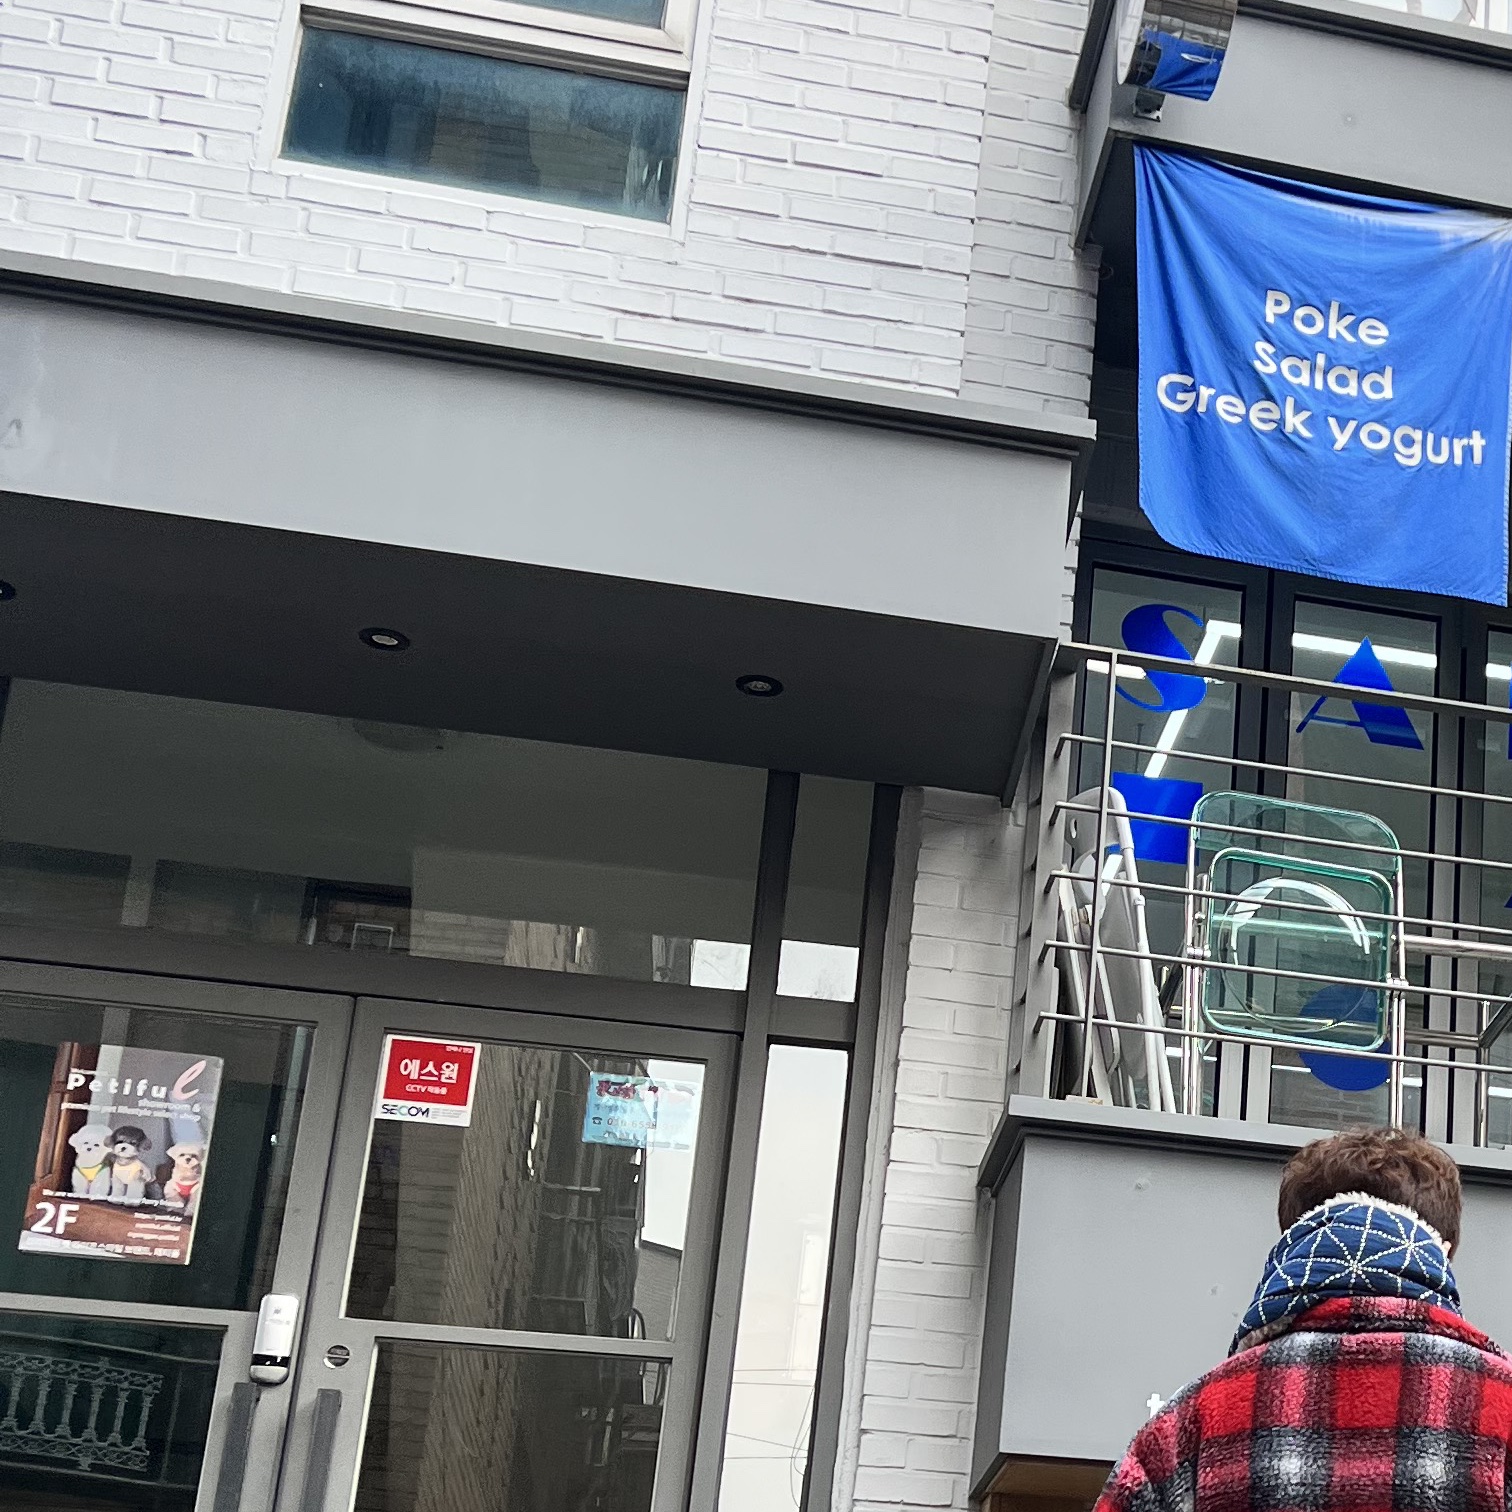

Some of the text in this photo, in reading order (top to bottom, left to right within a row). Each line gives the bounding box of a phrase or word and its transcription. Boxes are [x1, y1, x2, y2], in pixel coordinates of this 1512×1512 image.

[1264, 289, 1390, 345] Poke
[1253, 340, 1394, 400] Salad
[1156, 373, 1486, 467] Greek yogurt
[67, 1060, 207, 1101] Petiful
[400, 1058, 459, 1084] 에스원
[381, 1104, 430, 1118] SECOM
[30, 1201, 80, 1235] 2F
